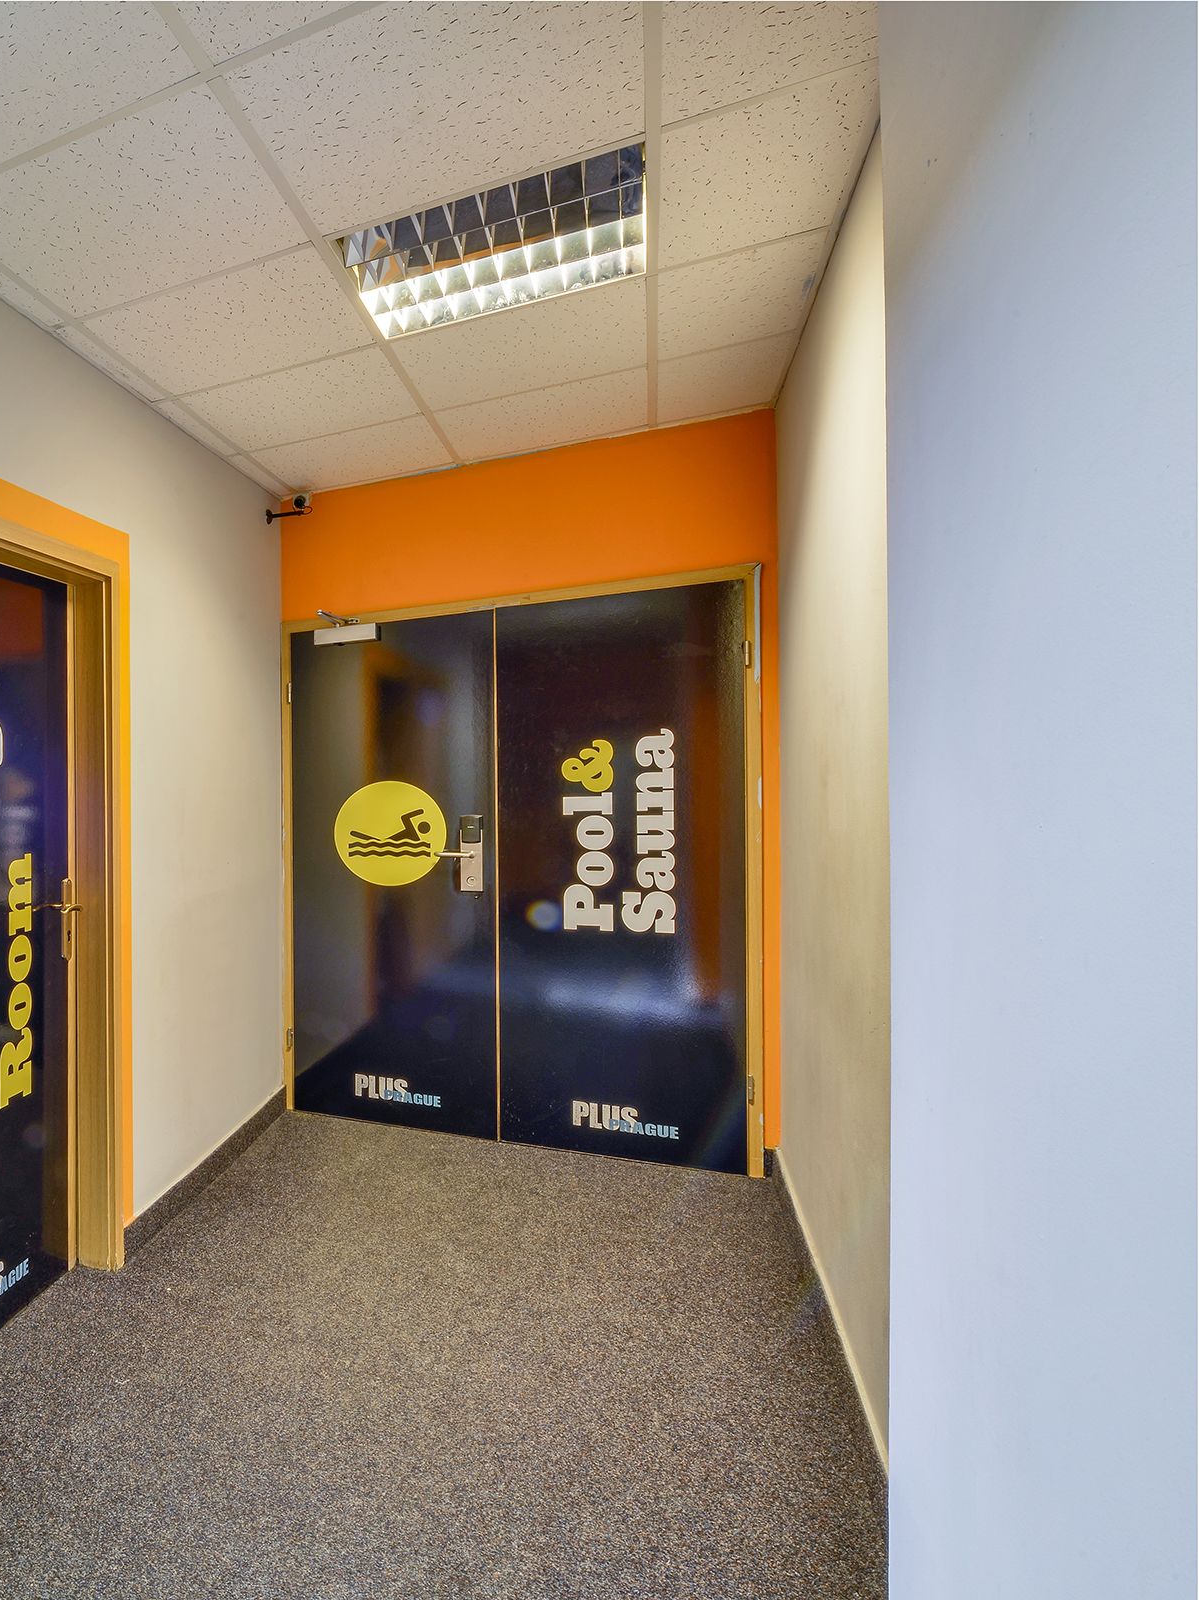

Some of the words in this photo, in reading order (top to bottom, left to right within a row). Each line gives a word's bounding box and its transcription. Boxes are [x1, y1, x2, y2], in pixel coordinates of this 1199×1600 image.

[621, 728, 676, 934] Sauna
[0, 853, 32, 1110] Room
[354, 1073, 408, 1102] PLUS
[383, 1089, 442, 1108] PRAGUE
[572, 1100, 639, 1132] PLUS
[609, 1118, 680, 1140] PRAGUE
